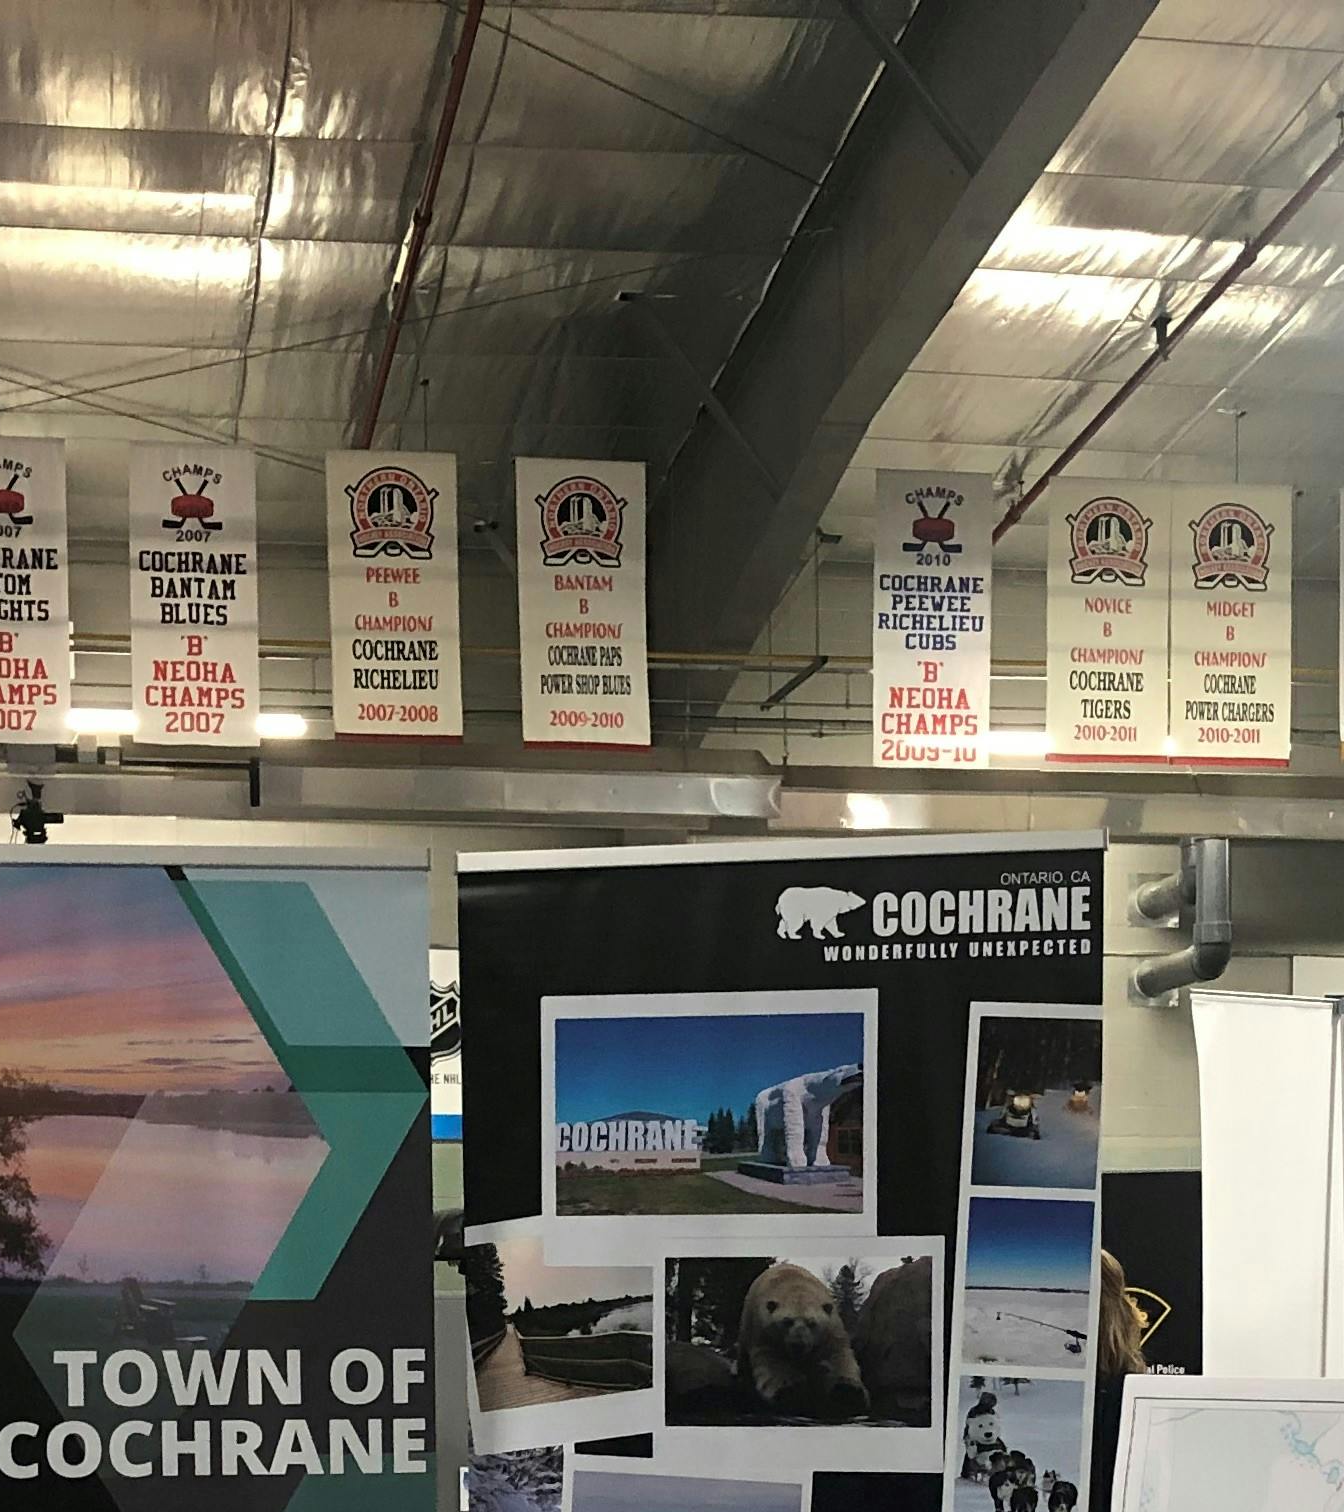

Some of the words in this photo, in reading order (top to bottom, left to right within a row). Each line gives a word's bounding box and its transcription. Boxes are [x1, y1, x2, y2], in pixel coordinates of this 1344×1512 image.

[138, 550, 247, 575] COCHRANE
[366, 567, 421, 584] PEEWEE
[555, 575, 612, 592] BANTAM
[879, 574, 984, 595] COCHRANE
[151, 577, 236, 600] BANTAM
[160, 603, 228, 626] BLUES
[891, 595, 971, 613] PEEWEE
[1084, 597, 1132, 615] NOVICE
[1206, 601, 1255, 619] MIDGET
[355, 615, 433, 632] CHAMPIONS
[545, 622, 623, 640] CHAMPIONS
[877, 614, 985, 633] RICHELIEU
[352, 639, 439, 661] COCHRANE
[905, 633, 957, 651] CUBS
[548, 646, 597, 666] COCHRANE
[152, 660, 236, 683] NEOHA
[353, 669, 439, 690] RICHELIEU
[1069, 670, 1144, 692] COCHRANE
[1204, 673, 1256, 695] COCHRANE
[145, 686, 245, 709] CHAMPS
[889, 687, 970, 710] NEOHA
[358, 704, 439, 723] 2007-2008
[1081, 698, 1131, 720] TIGERS
[1185, 700, 1219, 722] POWER
[1221, 701, 1274, 723] CHARGERS
[165, 712, 225, 734] 2007
[880, 713, 979, 736] CHAMPS
[1071, 871, 1091, 883] CA
[872, 886, 1091, 938] COCHRANE
[824, 942, 958, 962] WONDERFULLY
[969, 939, 1091, 957] UNEXPECTED
[555, 1119, 699, 1152] COCHRANE
[53, 1348, 302, 1408] TOWN
[330, 1347, 427, 1406] OF
